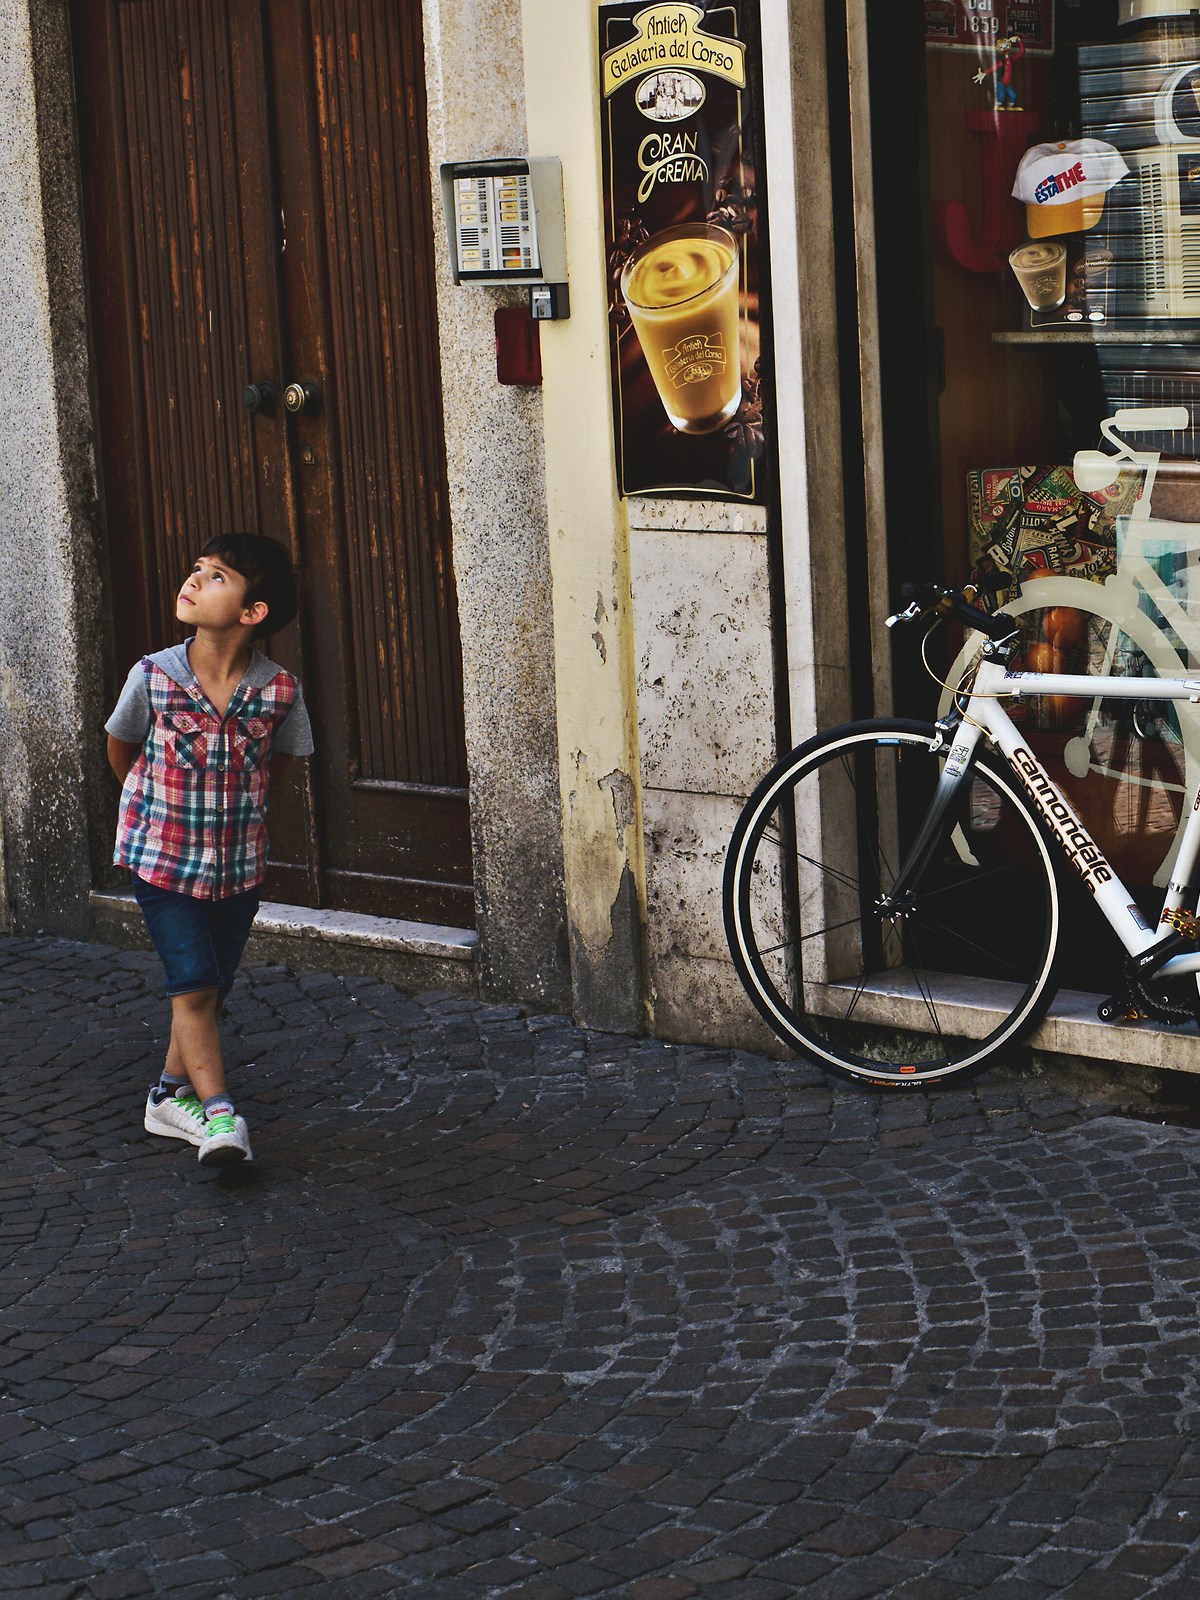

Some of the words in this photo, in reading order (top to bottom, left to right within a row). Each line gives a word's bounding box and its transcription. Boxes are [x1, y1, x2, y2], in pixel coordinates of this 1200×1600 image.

[962, 16, 999, 34] 1859
[611, 43, 666, 78] Gelateria
[669, 40, 689, 58] del
[692, 41, 733, 70] Corso
[657, 160, 704, 183] CREMA
[1001, 526, 1017, 555] Buton
[1013, 747, 1112, 884] cannondale
